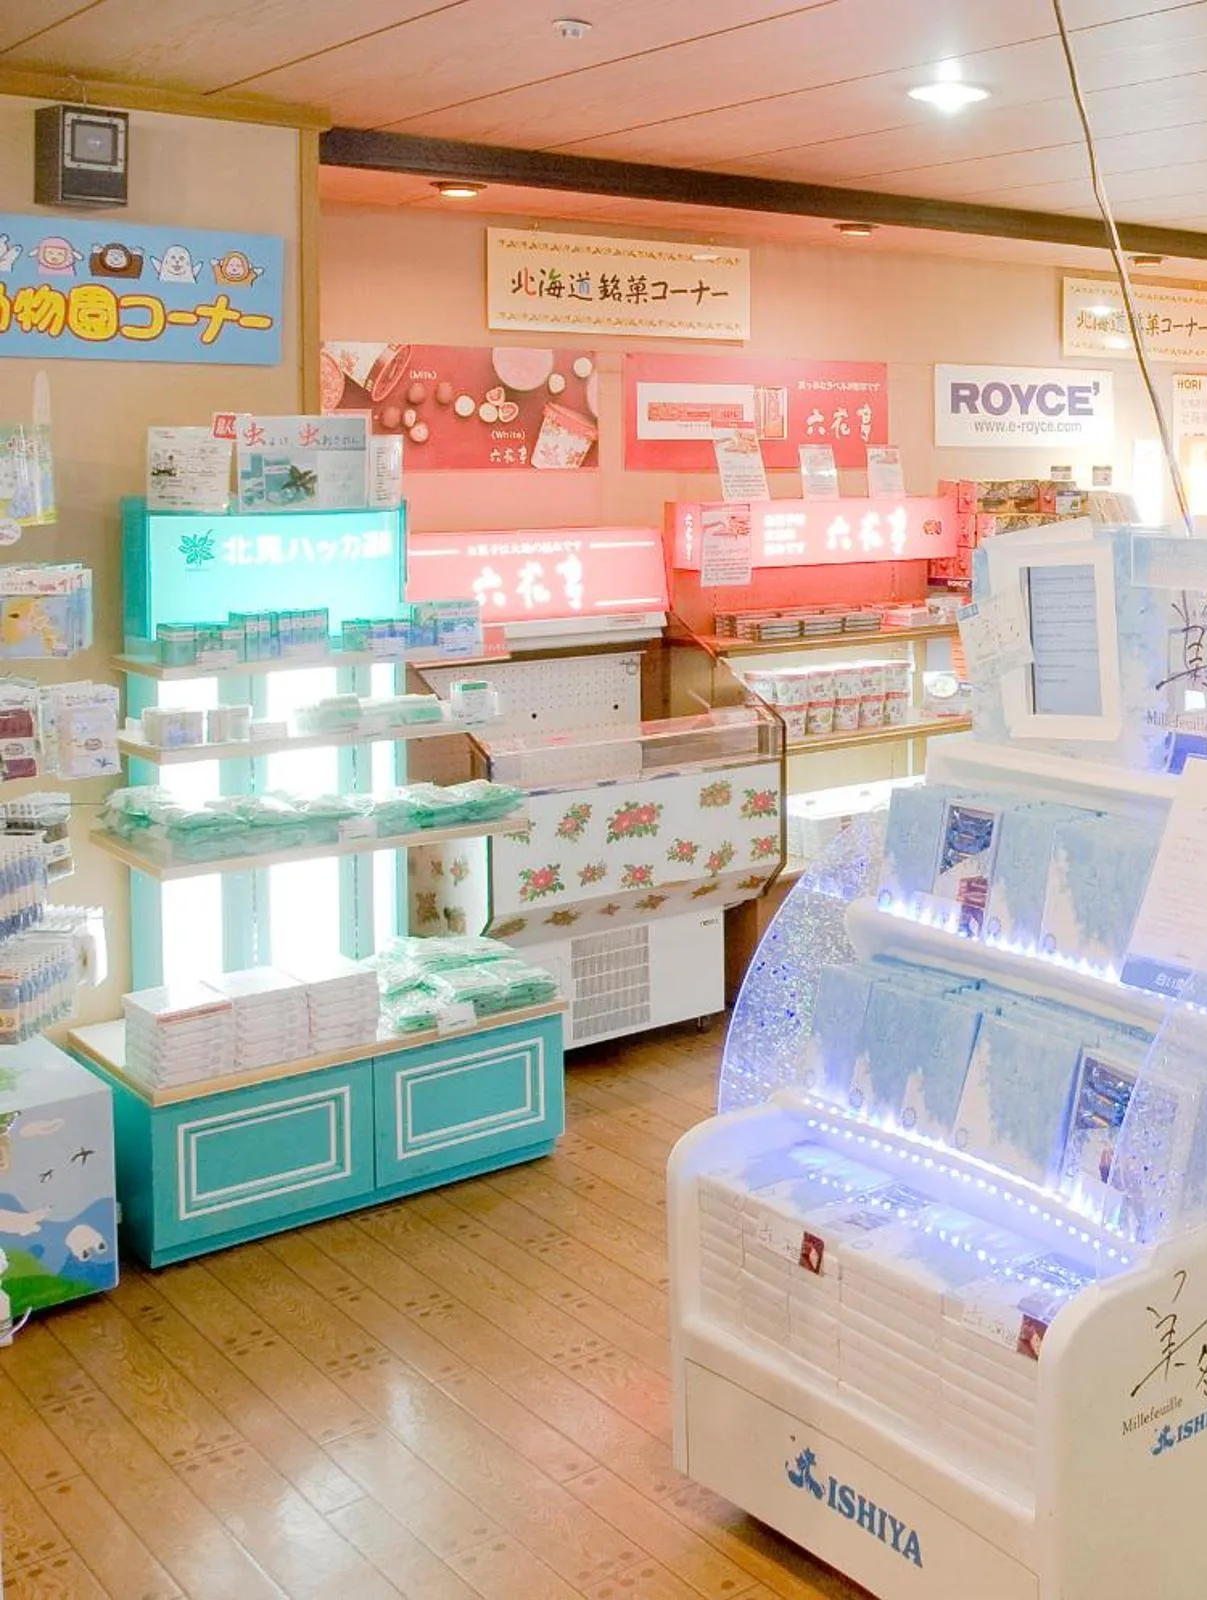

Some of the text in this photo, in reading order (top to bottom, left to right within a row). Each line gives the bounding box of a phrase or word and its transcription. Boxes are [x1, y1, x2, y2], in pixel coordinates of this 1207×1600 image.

[511, 267, 730, 305] 北海道銘菓コーナー
[0, 282, 273, 345] 物園コーナー
[950, 381, 1100, 416] ROYCE'
[1177, 379, 1202, 391] HORI
[491, 429, 526, 441] (White)
[805, 402, 873, 442] 六花亭
[973, 419, 1083, 436] www.e-royce.com
[1121, 1396, 1183, 1436] Millefeuille
[826, 1475, 924, 1569] ISHIYA
